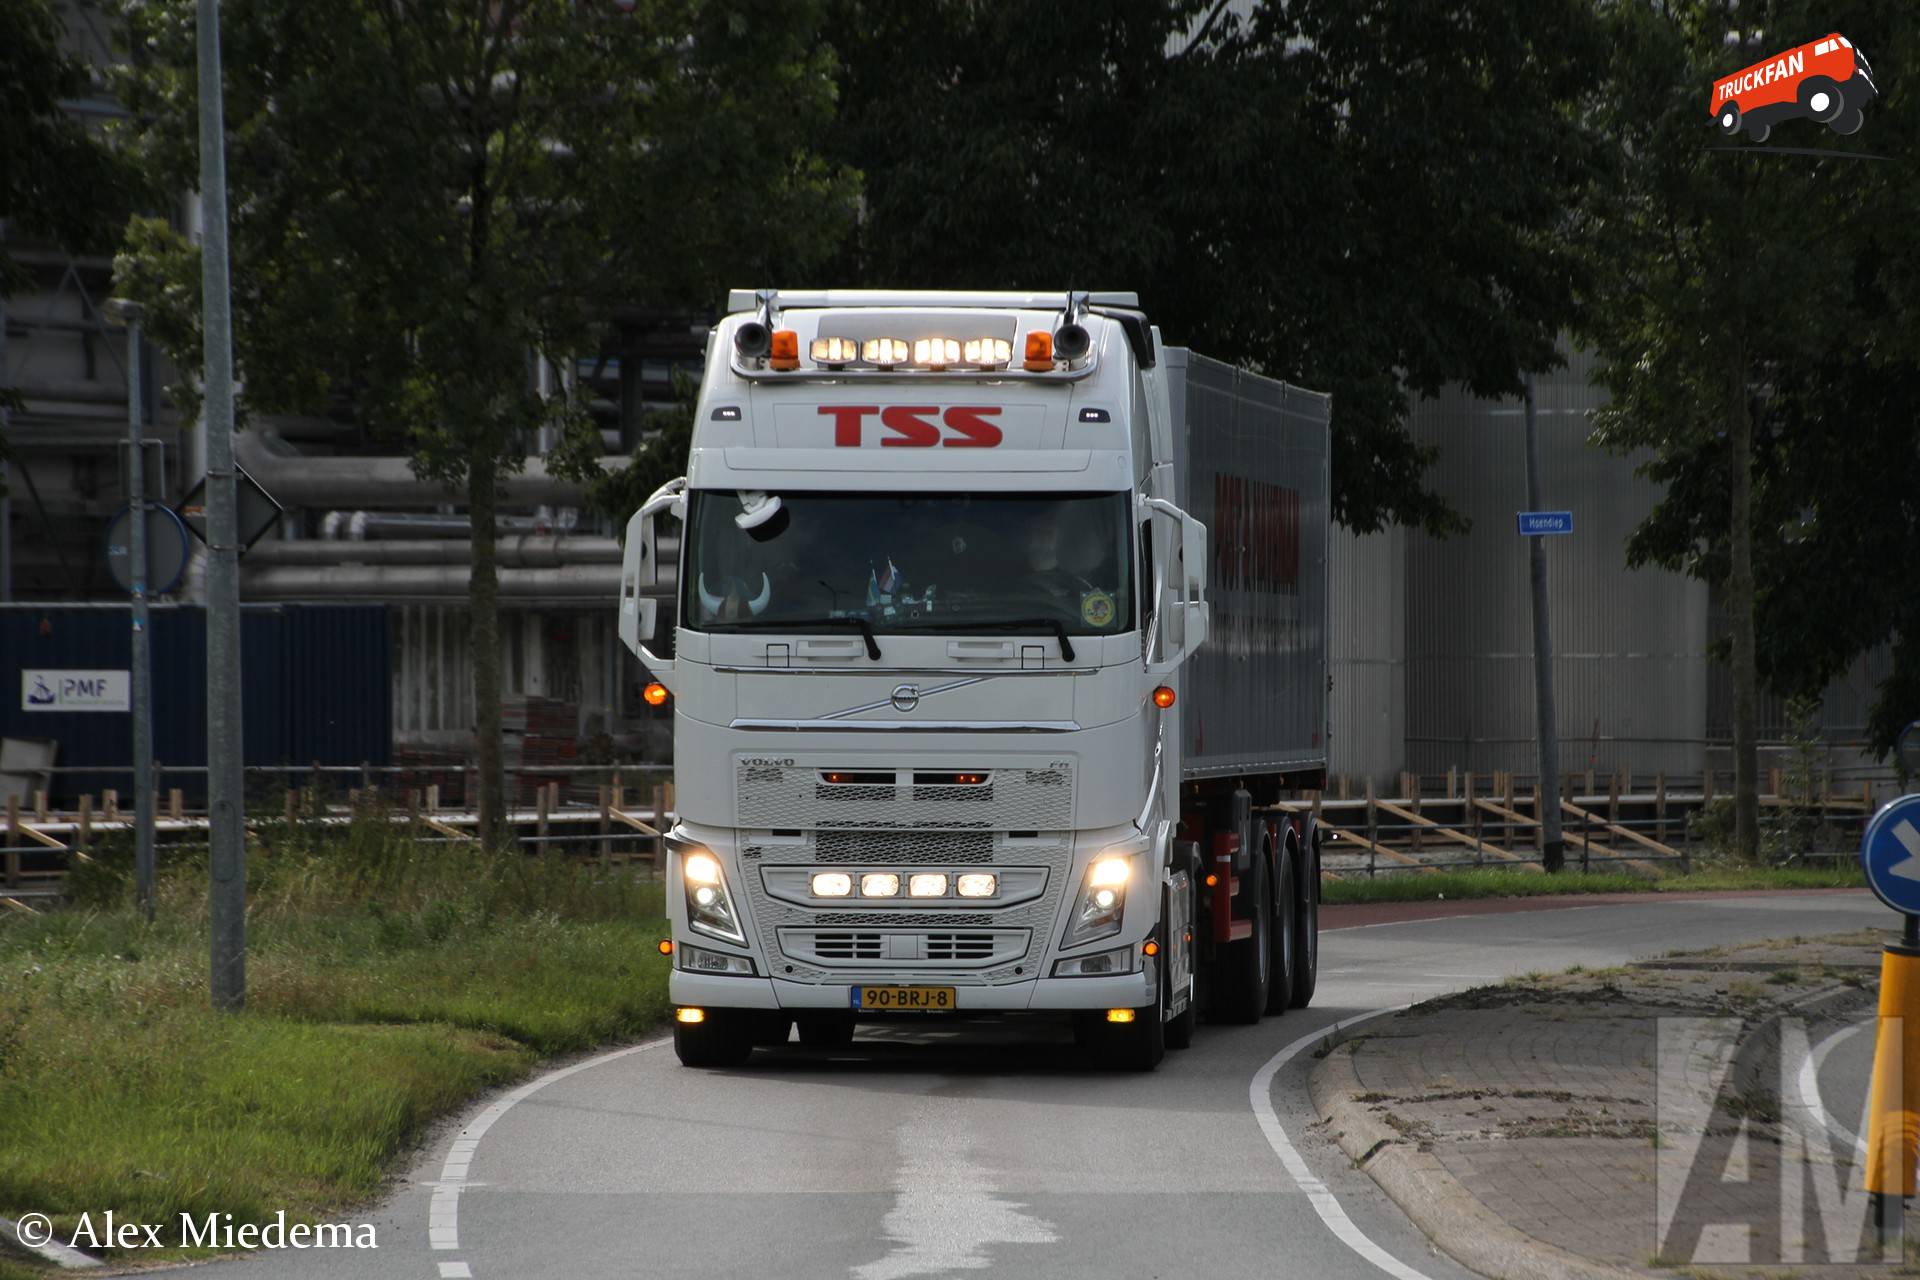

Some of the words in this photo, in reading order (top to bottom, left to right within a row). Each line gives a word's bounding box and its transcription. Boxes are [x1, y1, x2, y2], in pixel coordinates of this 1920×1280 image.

[817, 405, 1004, 448] TSS
[64, 679, 107, 697] PMF
[739, 757, 795, 767] VOLVO
[866, 990, 948, 1006] 90-BRJ-8
